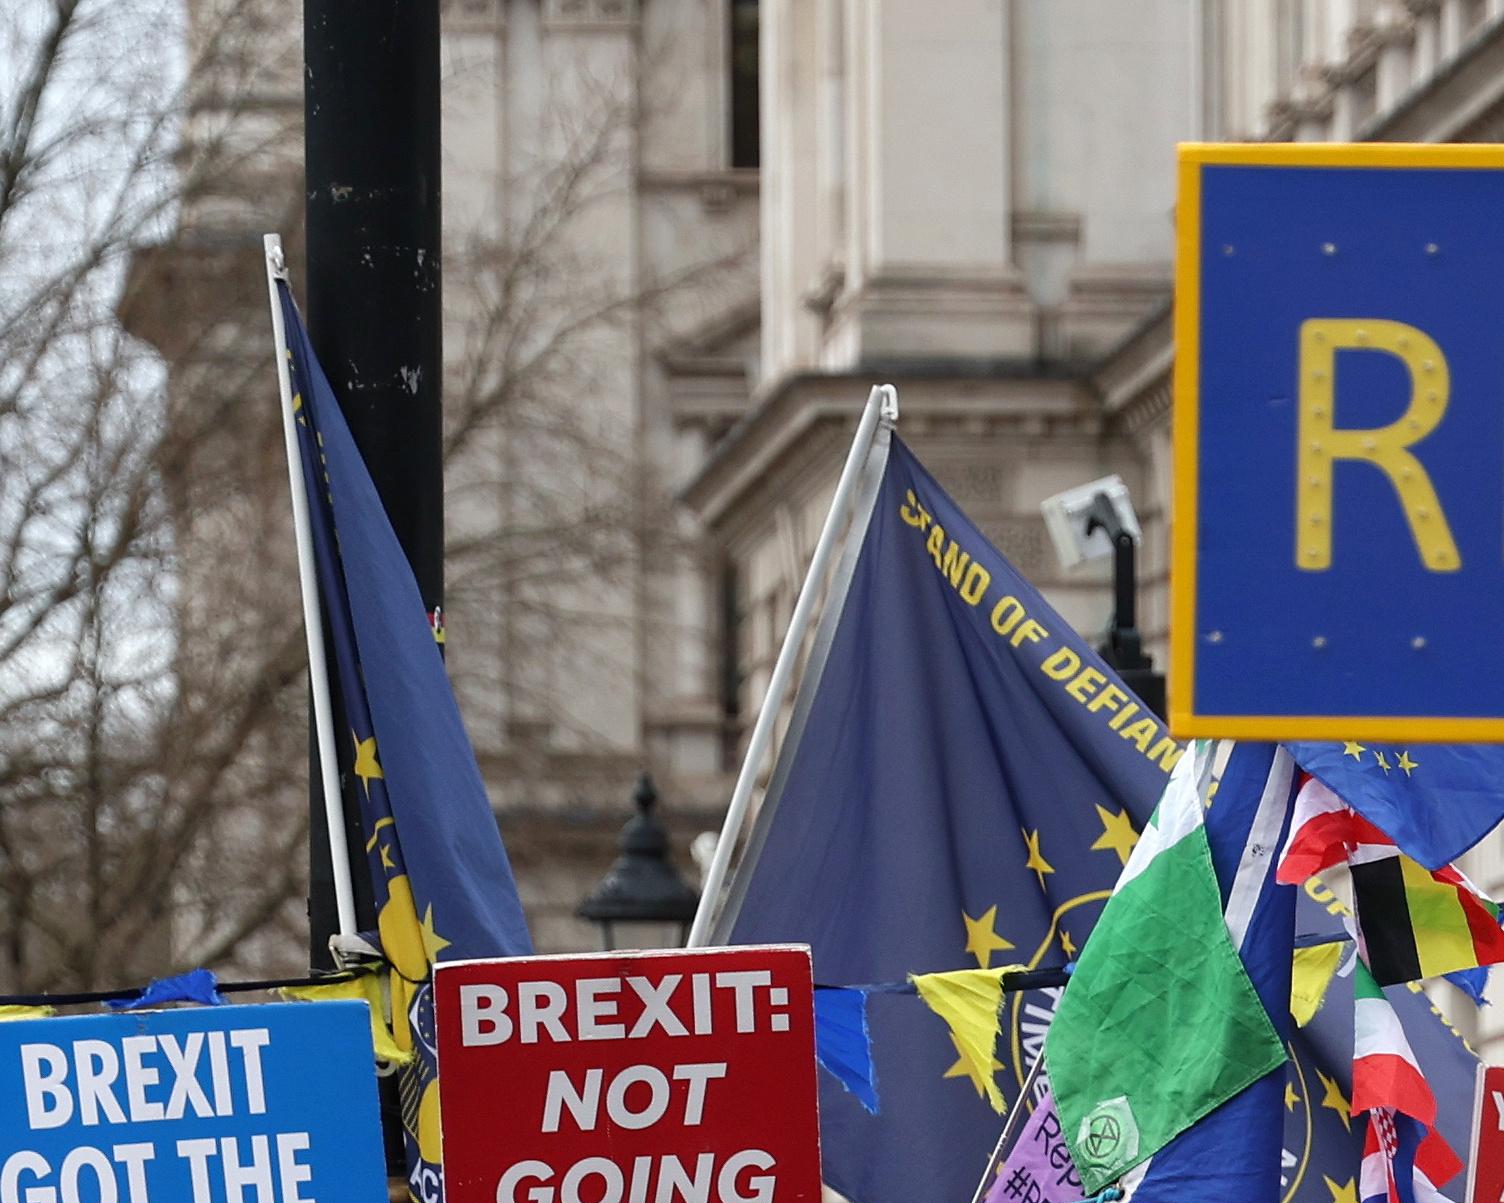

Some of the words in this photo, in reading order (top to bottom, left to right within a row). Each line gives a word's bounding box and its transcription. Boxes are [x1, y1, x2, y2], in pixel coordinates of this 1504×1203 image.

[990, 595, 1049, 648] OF
[1040, 645, 1186, 774] DEFIAN
[460, 970, 790, 1047] BREXIT:
[21, 1028, 271, 1130] BREXIT
[541, 1062, 727, 1133] NOT
